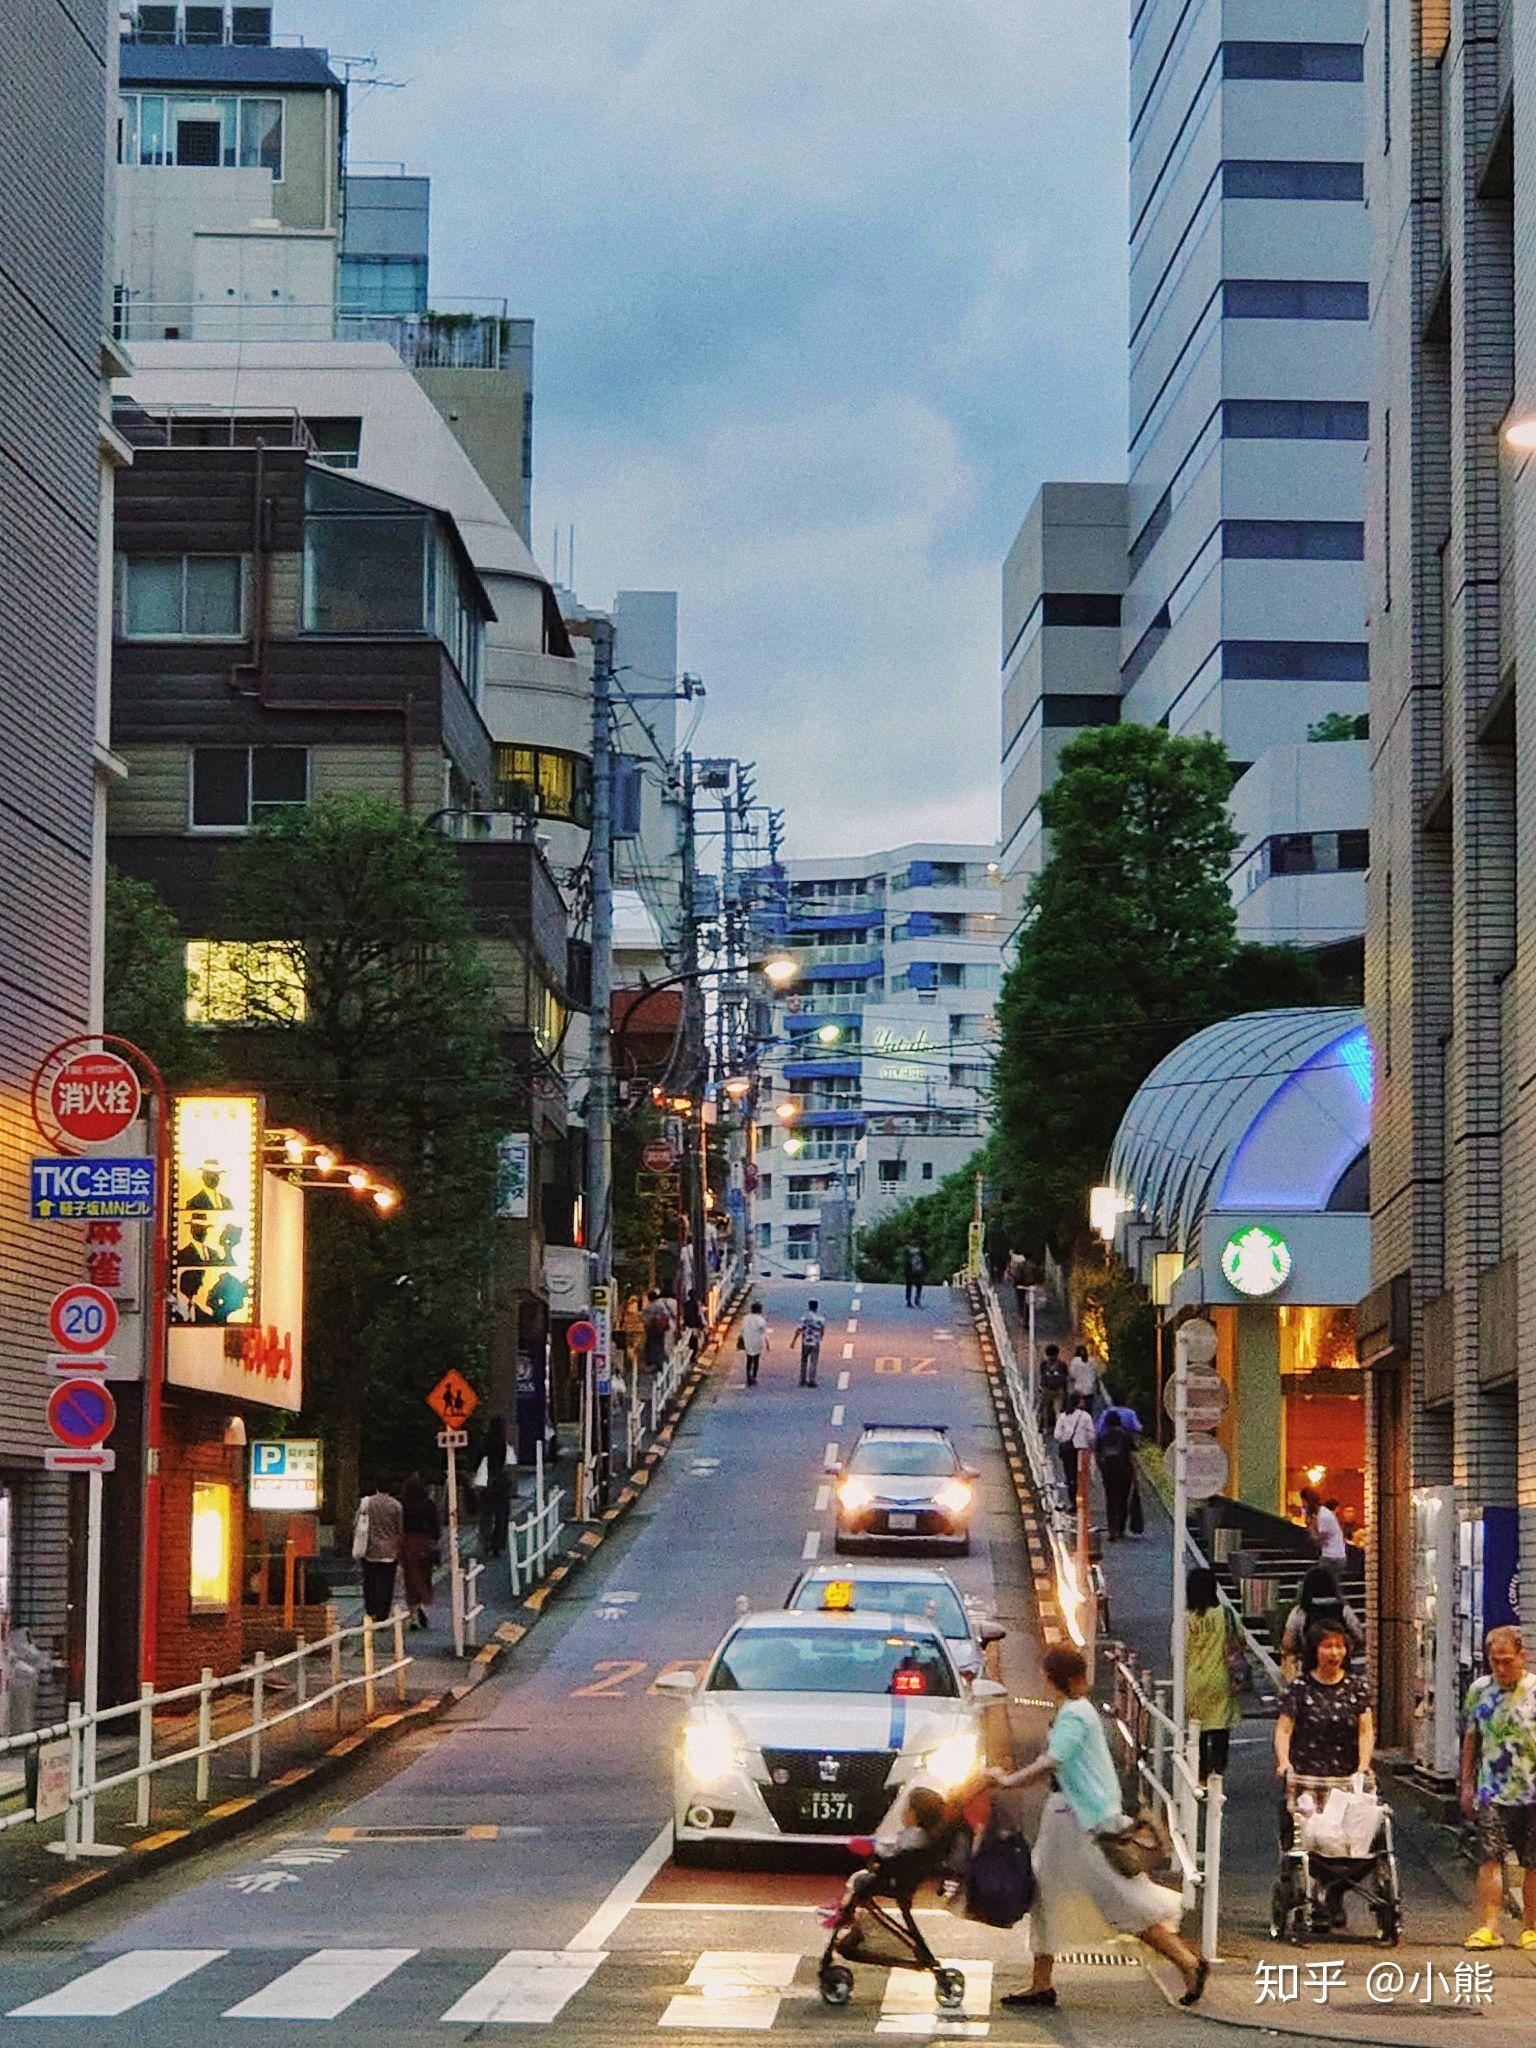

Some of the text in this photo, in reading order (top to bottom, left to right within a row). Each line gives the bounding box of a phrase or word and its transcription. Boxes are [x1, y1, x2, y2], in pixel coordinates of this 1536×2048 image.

[59, 1081, 132, 1115] 消火栓
[33, 1165, 151, 1197] TKC全国会
[65, 1305, 103, 1333] 20
[261, 1446, 281, 1471] P
